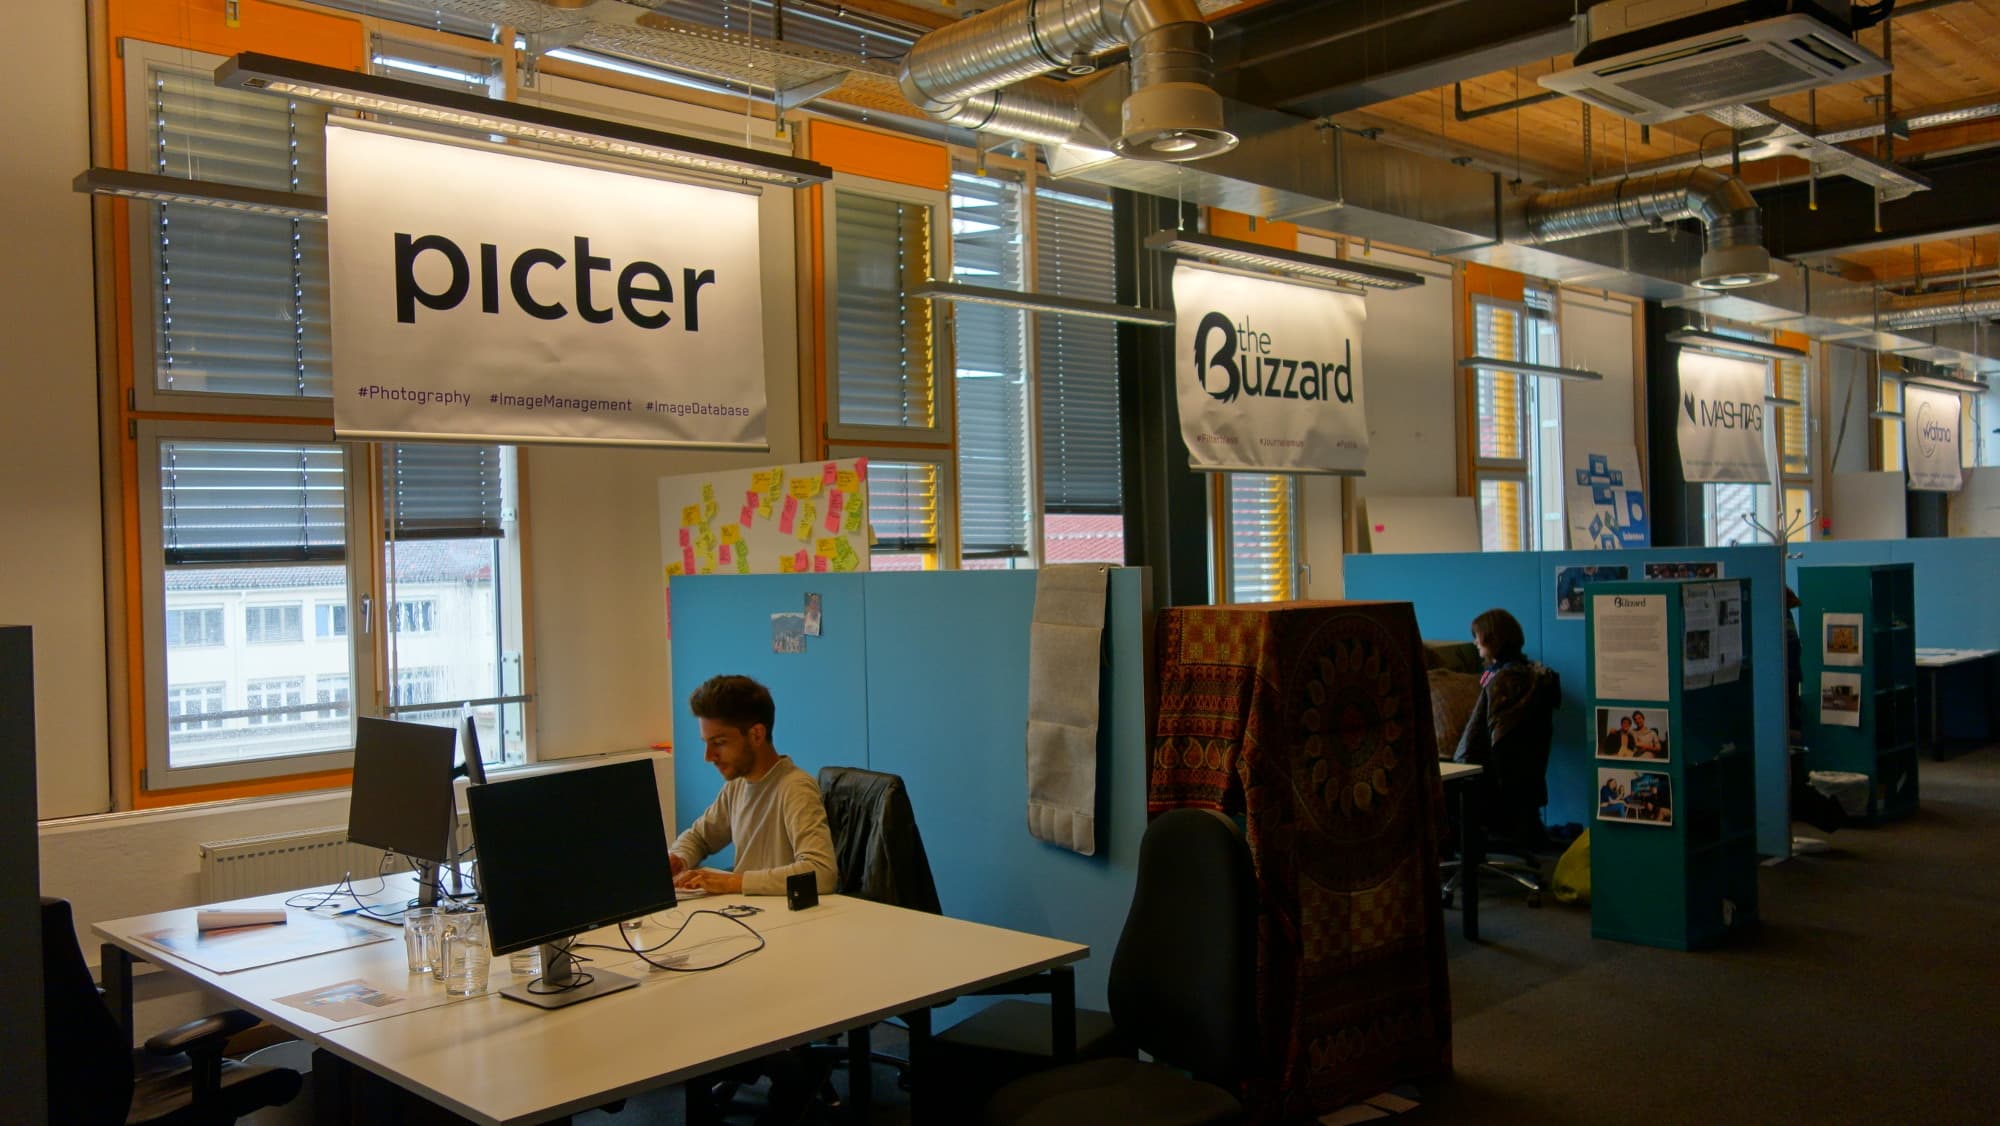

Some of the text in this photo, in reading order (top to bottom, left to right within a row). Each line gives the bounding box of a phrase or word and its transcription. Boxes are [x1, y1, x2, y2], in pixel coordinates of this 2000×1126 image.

[394, 232, 715, 332] picter
[1237, 315, 1271, 355] the
[1194, 311, 1354, 404] Buzzard
[357, 385, 749, 417] #Photography #ImageManagement #ImageDatabase
[1700, 399, 1762, 432] MASHTAG
